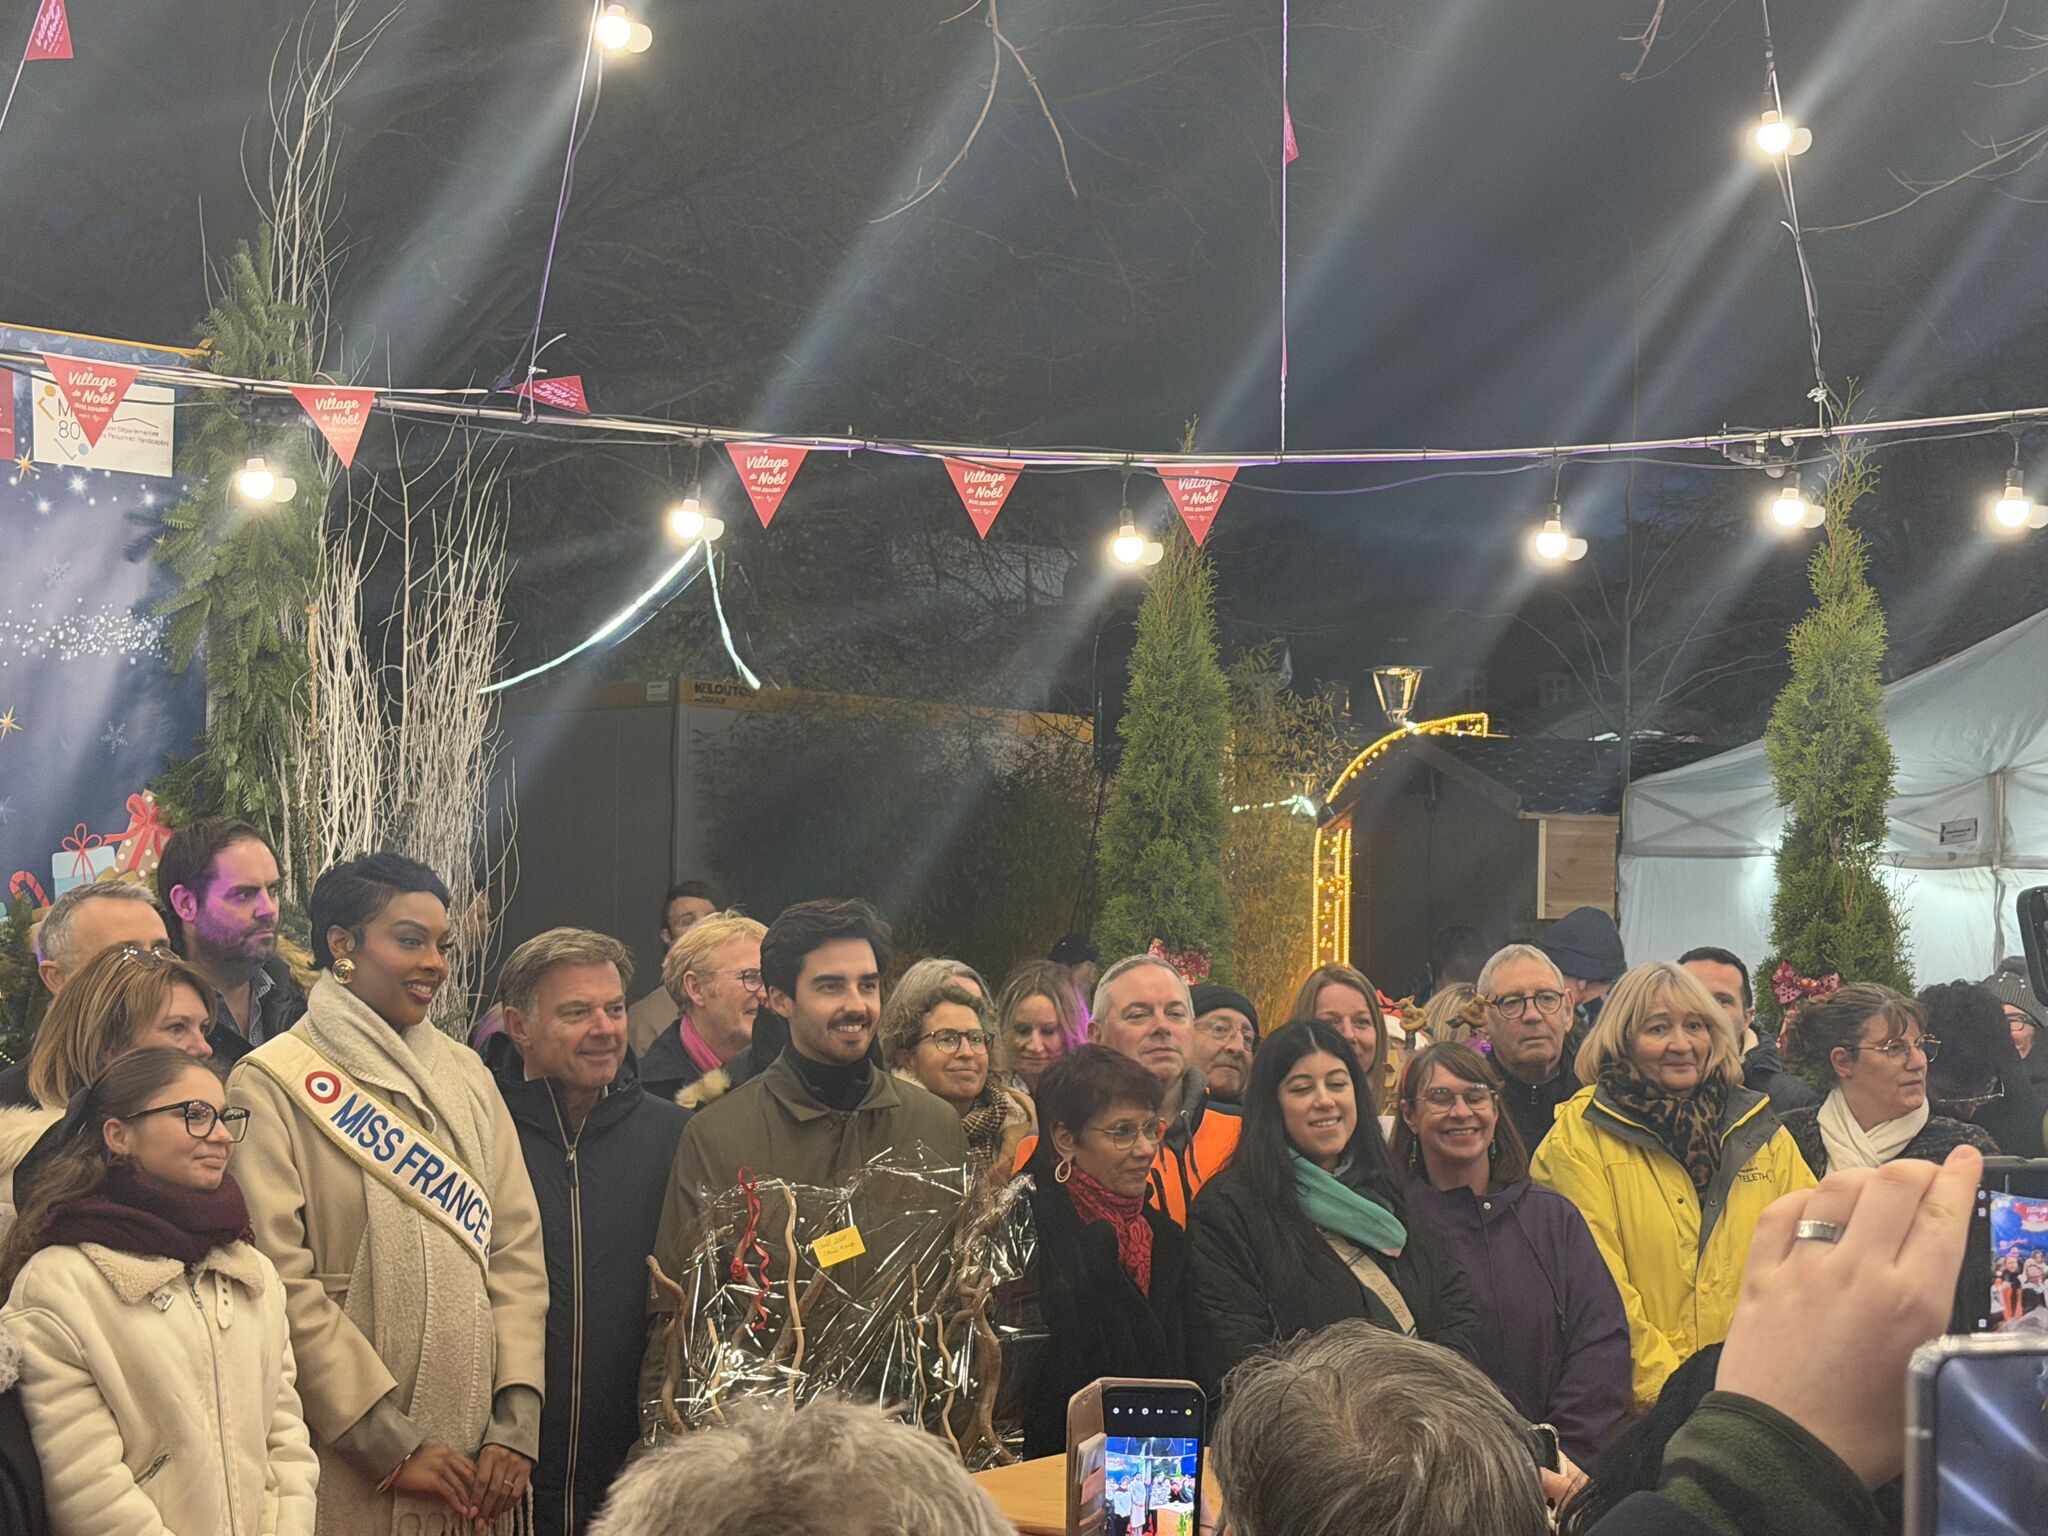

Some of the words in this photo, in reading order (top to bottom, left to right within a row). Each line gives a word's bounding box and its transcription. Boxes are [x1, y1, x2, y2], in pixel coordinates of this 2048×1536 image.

[68, 371, 118, 393] Village
[82, 391, 115, 405] Noël
[315, 397, 360, 415] Village
[331, 412, 361, 426] Noël
[58, 420, 81, 440] 80
[746, 455, 790, 474] Village
[758, 471, 787, 485] Noël
[963, 470, 1007, 488] Village
[1178, 478, 1222, 493] Village
[975, 485, 1004, 498] Noël
[1190, 490, 1219, 505] Noël
[330, 1094, 405, 1163] MISS
[392, 1142, 491, 1246] FRANCE
